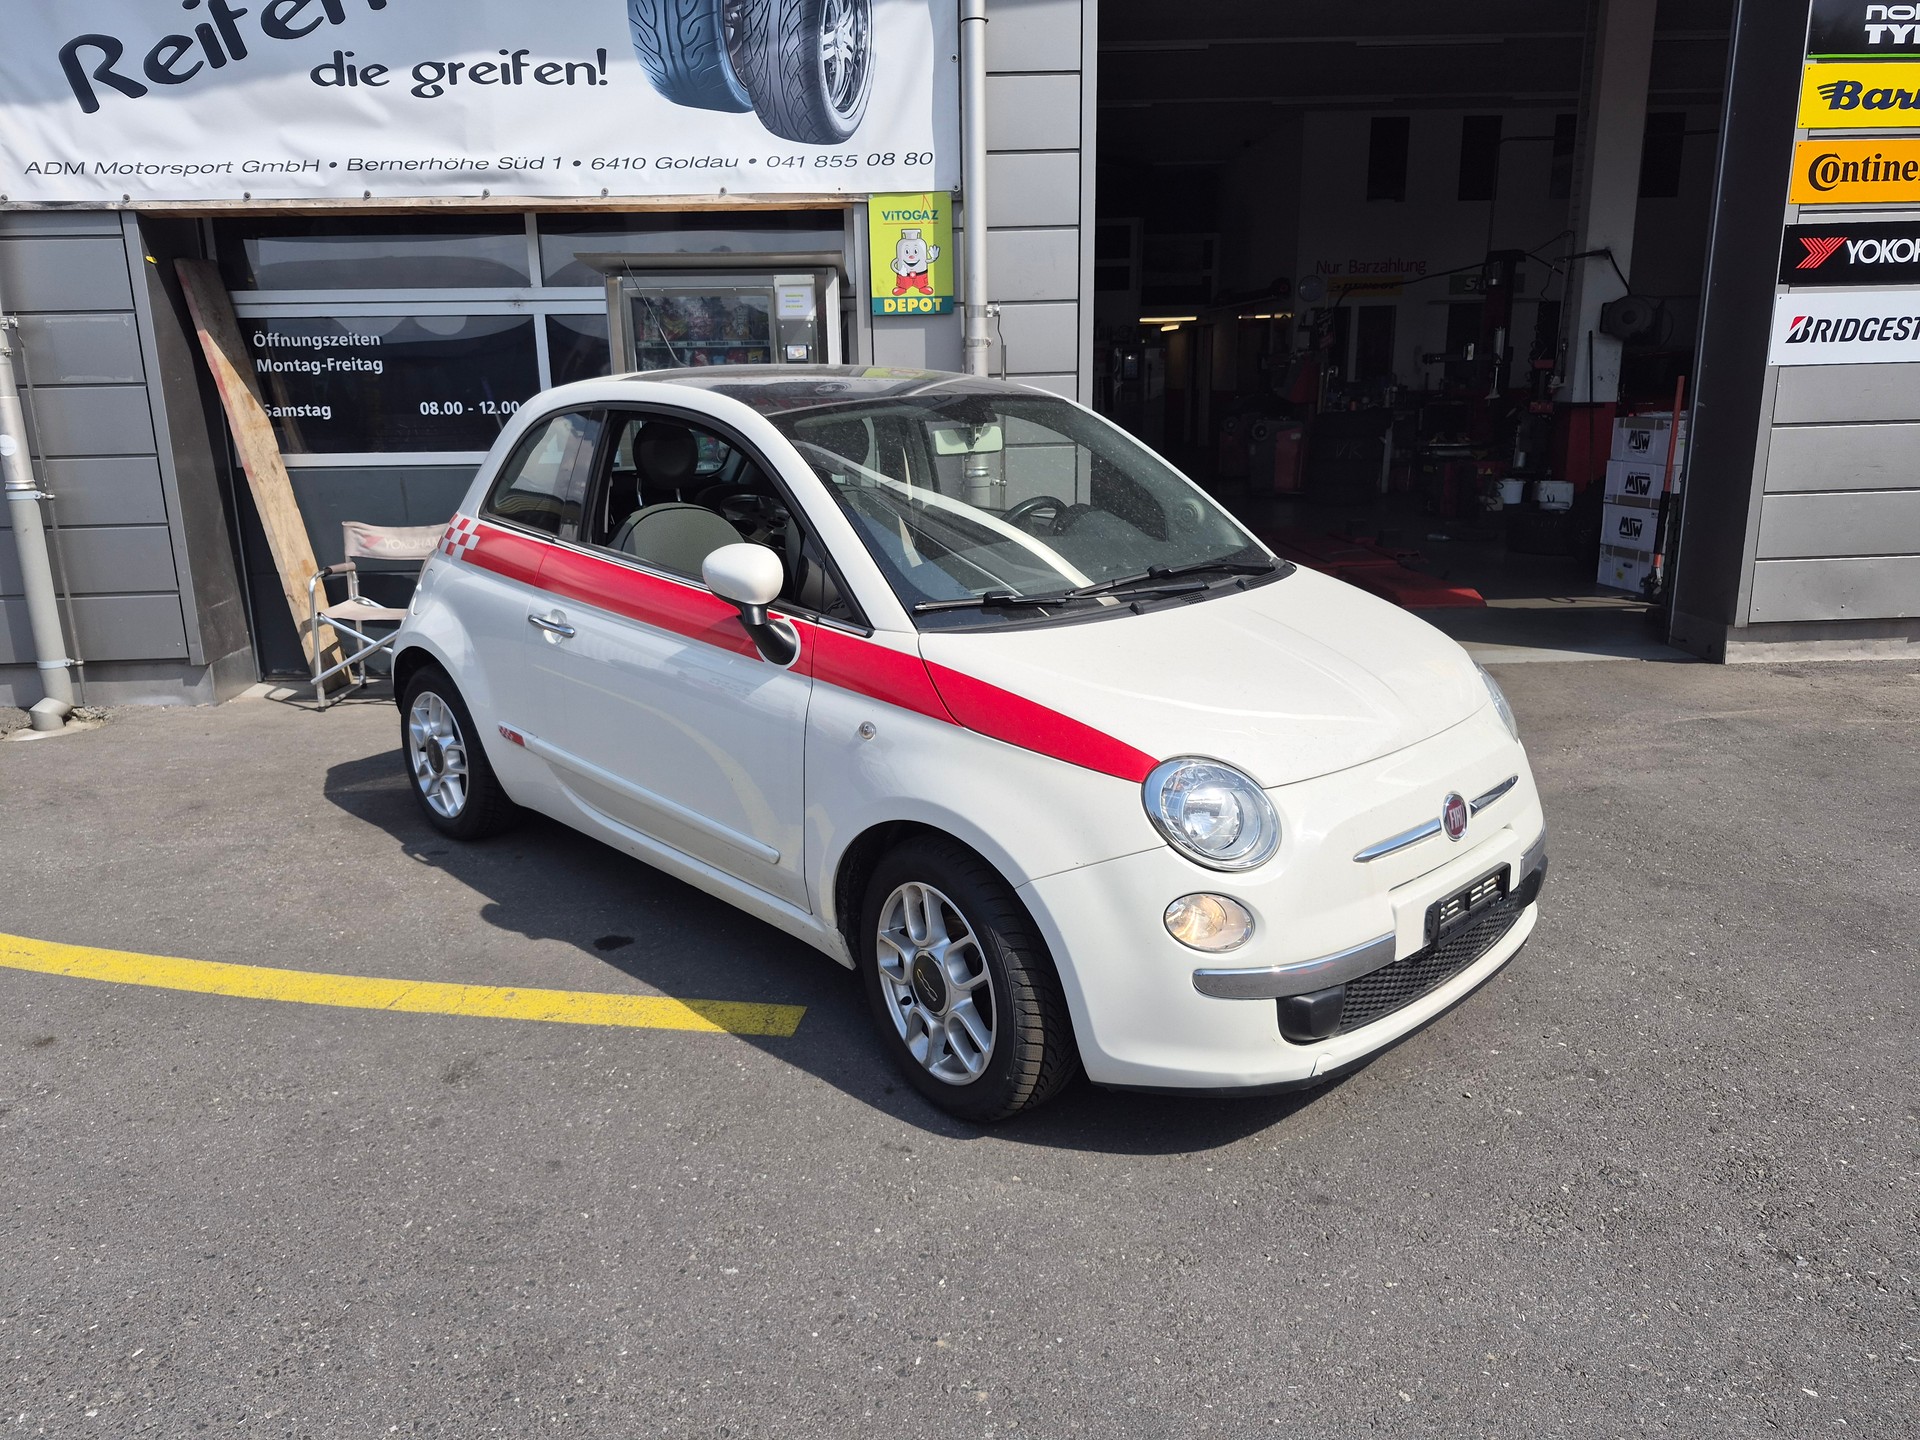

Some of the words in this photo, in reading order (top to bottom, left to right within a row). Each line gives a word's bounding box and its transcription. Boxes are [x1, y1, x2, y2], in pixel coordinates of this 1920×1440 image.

[57, 0, 388, 115] Reife
[309, 49, 390, 87] die
[410, 47, 608, 99] greifen!
[1817, 79, 1920, 111] Bar
[23, 161, 86, 176] ADM
[93, 161, 234, 178] Motorsport
[242, 159, 321, 174] GmbH
[346, 157, 490, 172] Bernerhöhe
[497, 155, 546, 171] Süd
[552, 157, 563, 170] 1
[590, 157, 647, 170] 6410
[655, 155, 739, 170] Goldau
[766, 155, 806, 169] 041
[814, 154, 858, 168] 855
[866, 153, 897, 167] 08
[903, 152, 934, 167] 80
[1808, 152, 1920, 192] Contine
[1316, 259, 1342, 275] Nur
[1348, 257, 1427, 275] Barzahlung
[883, 297, 943, 313] DEPOT
[253, 330, 381, 350] Öffnungszeiten
[256, 356, 384, 376] Montag-Freitag
[264, 403, 332, 420] Samstag
[419, 401, 463, 416] 08.00
[478, 400, 521, 416] 12.00
[1629, 429, 1651, 450] MSW
[1625, 474, 1651, 496] MSW
[1619, 516, 1643, 538] MSW
[1449, 804, 1464, 830] FIAT
